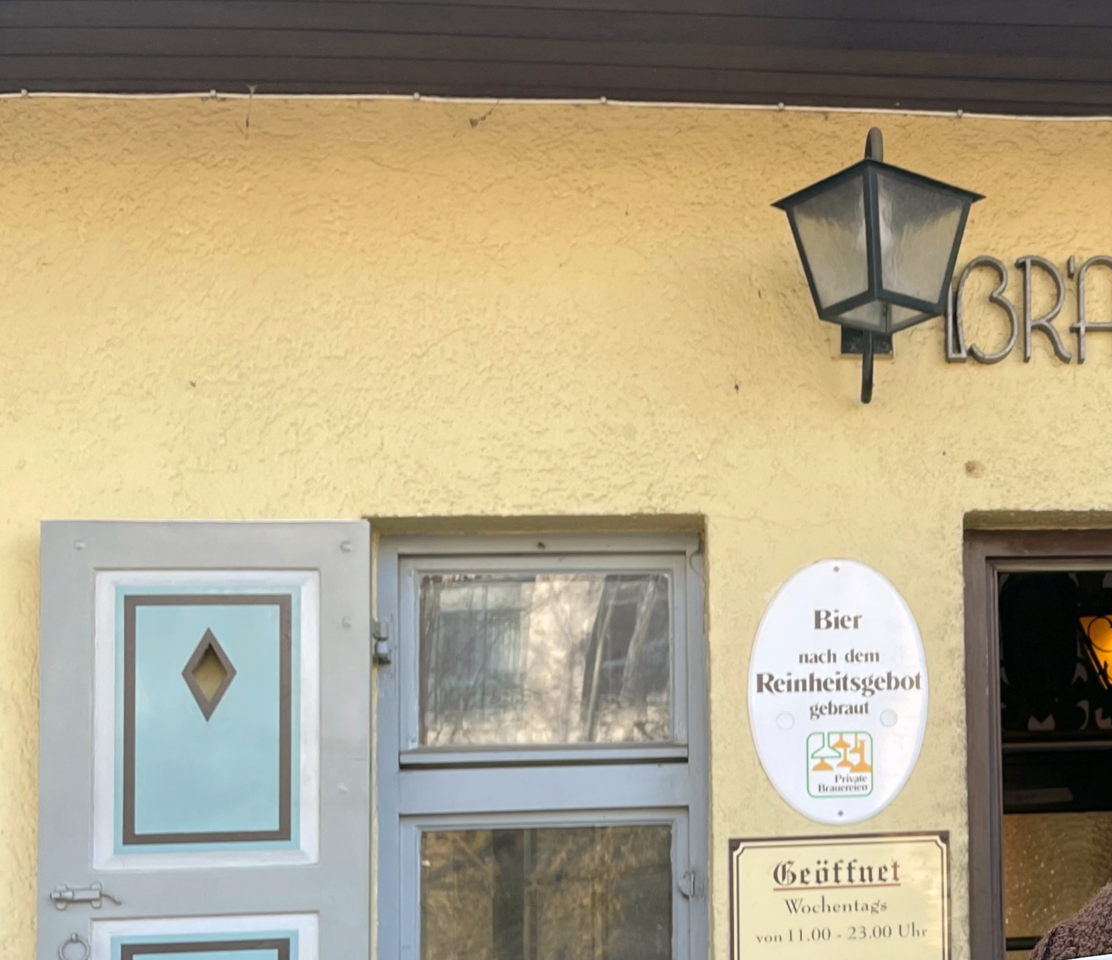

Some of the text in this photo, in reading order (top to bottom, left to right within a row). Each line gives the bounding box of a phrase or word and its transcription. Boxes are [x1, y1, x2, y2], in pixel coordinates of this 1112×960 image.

[813, 608, 863, 631] Bier
[799, 648, 880, 665] nach dem
[755, 670, 922, 697] Reinheitsgebot
[809, 701, 870, 721] gebraut
[834, 773, 868, 784] Private
[773, 858, 901, 886] Geöffnet
[784, 895, 888, 916] Wochentags
[755, 933, 782, 944] von
[787, 927, 831, 943] 11.00
[847, 925, 892, 940] 23.00
[898, 922, 928, 939] Uhr
